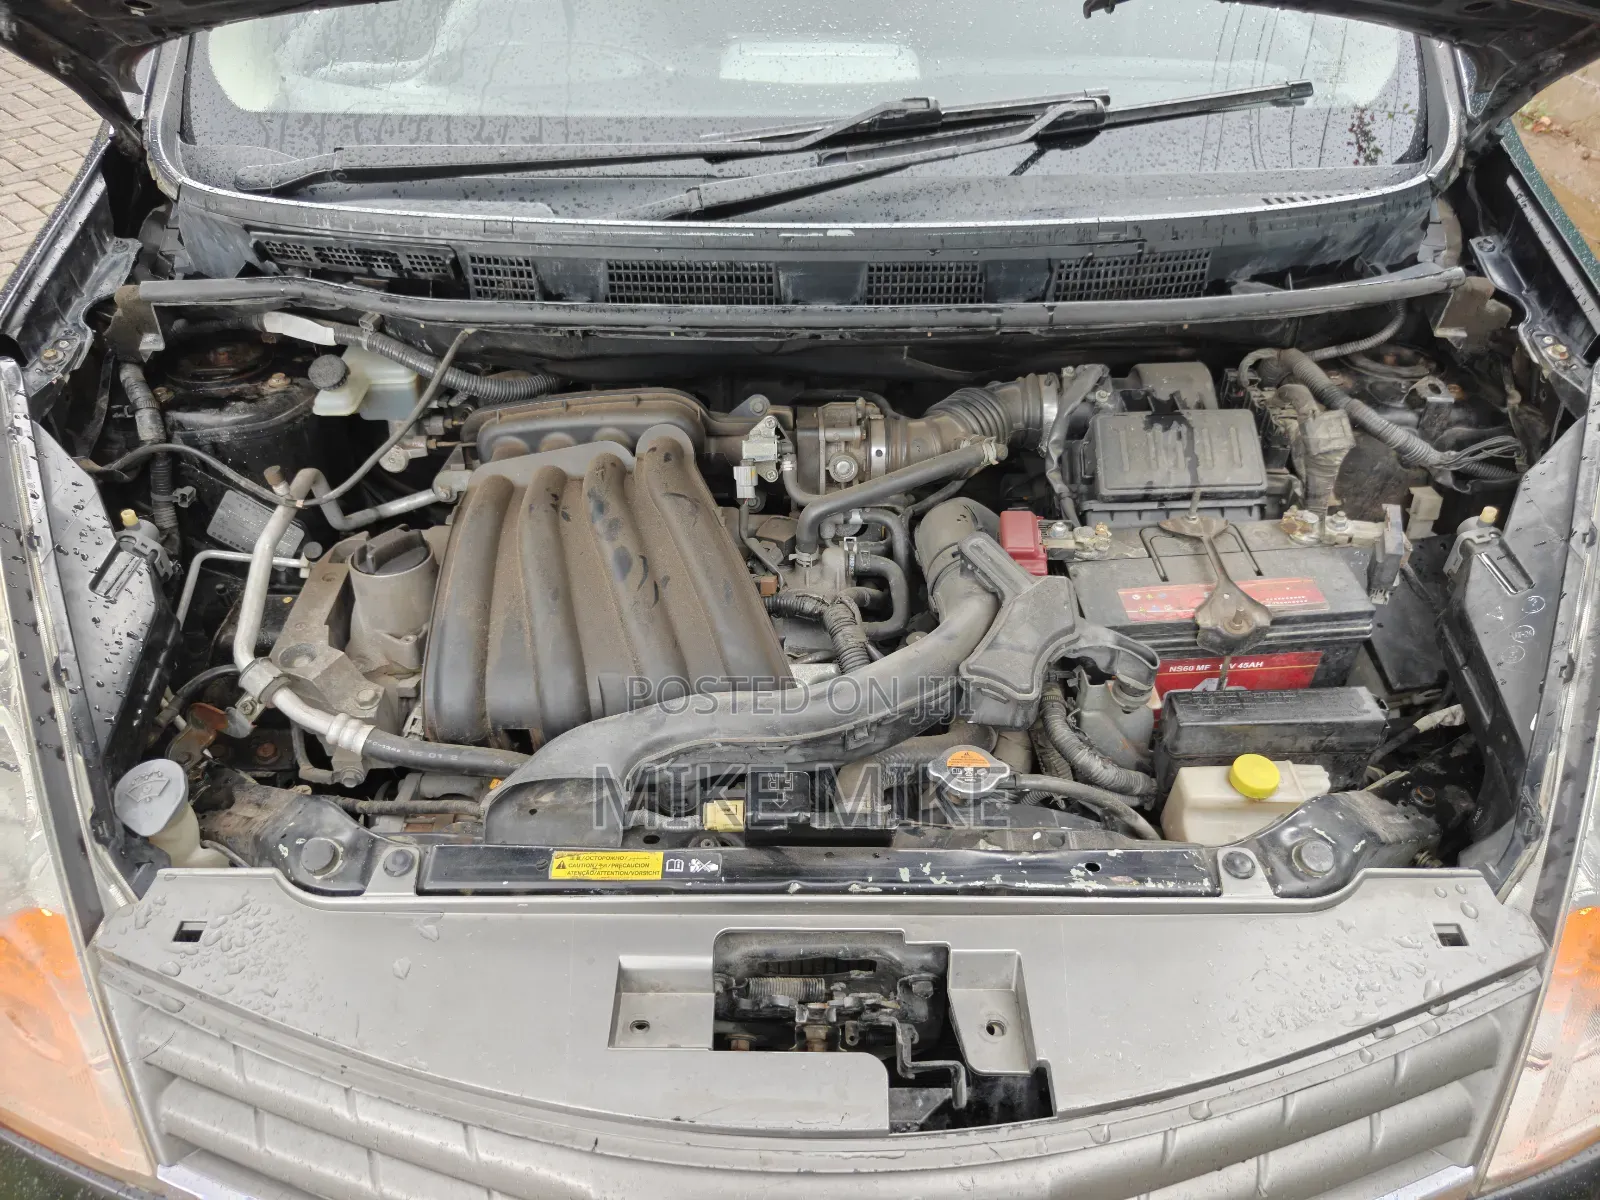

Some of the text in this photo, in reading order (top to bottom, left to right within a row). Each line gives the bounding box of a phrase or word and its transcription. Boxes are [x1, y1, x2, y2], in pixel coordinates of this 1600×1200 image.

[1218, 662, 1237, 670] 1V
[1237, 661, 1264, 669] 45AH
[768, 773, 794, 791] FR
